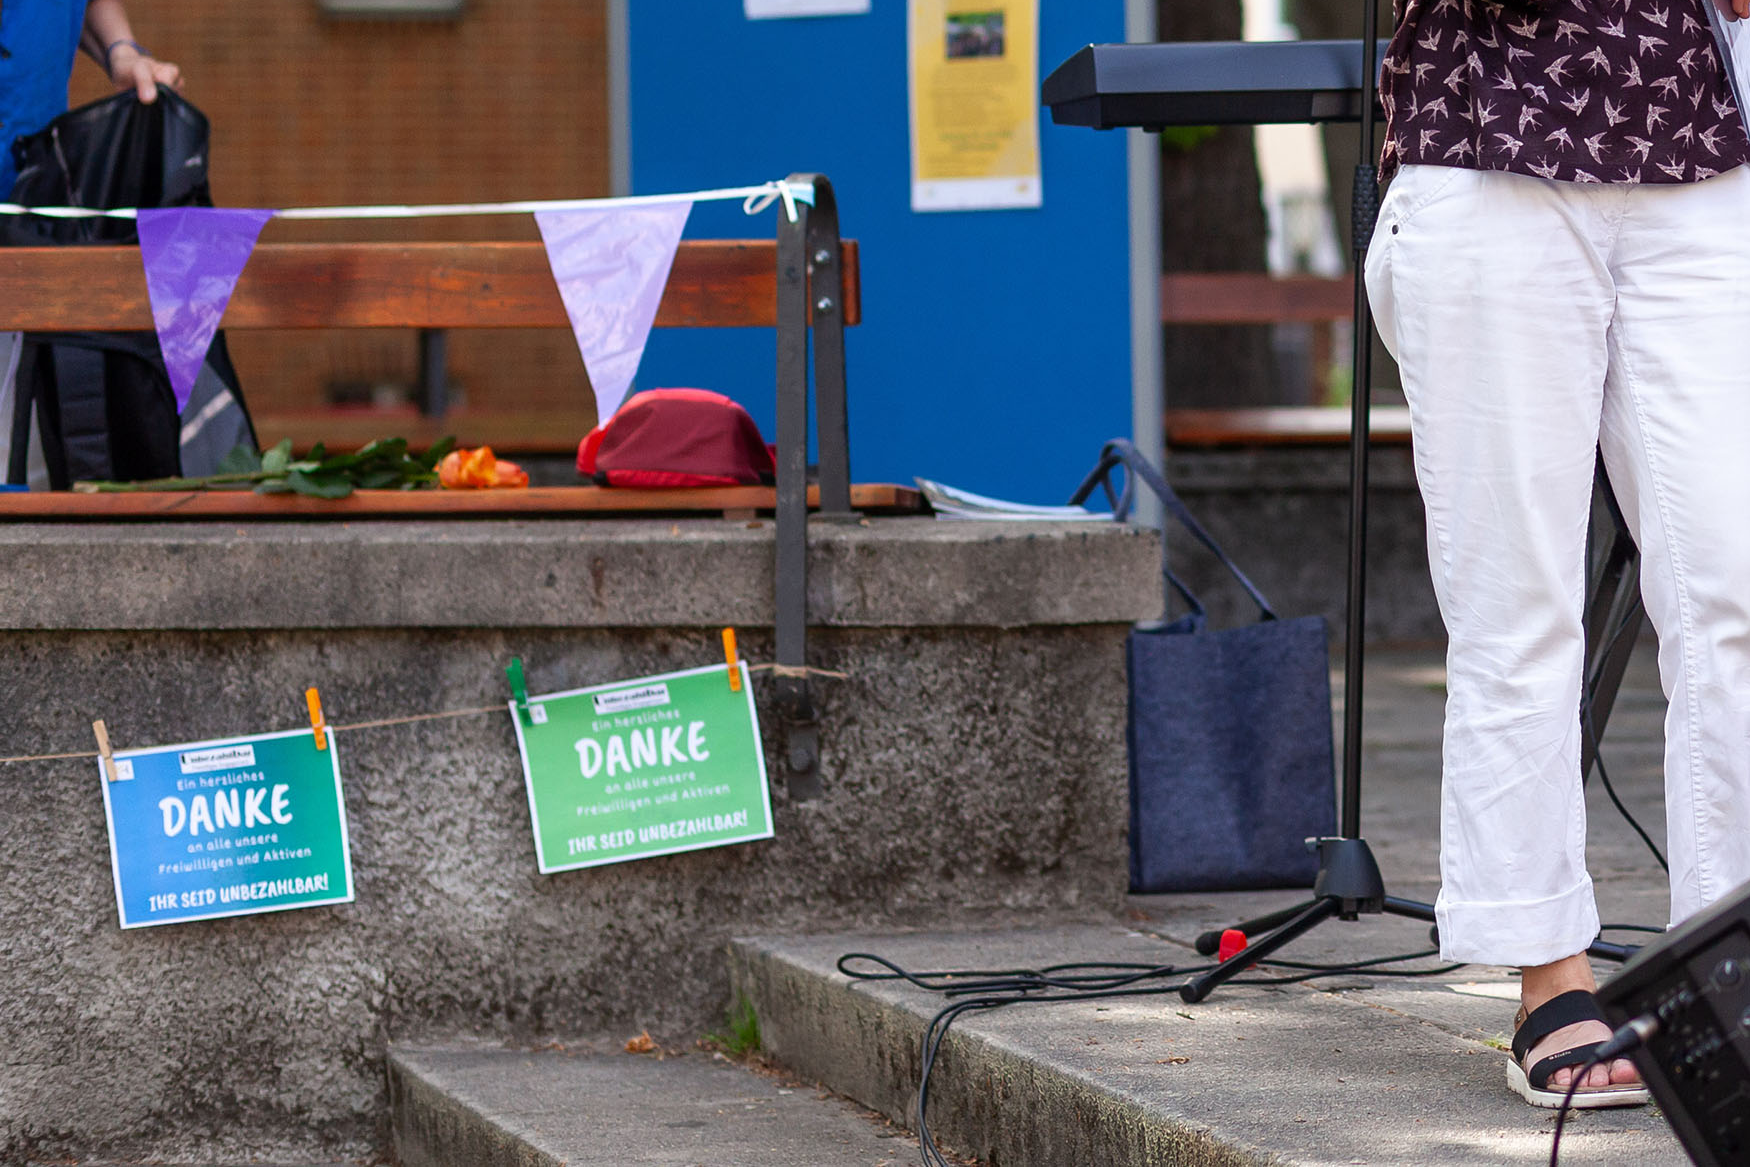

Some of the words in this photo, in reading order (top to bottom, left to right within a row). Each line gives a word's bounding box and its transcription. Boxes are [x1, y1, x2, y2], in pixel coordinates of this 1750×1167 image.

[592, 720, 612, 732] Ein
[574, 721, 710, 779] DANKE
[176, 779, 196, 791] Ein
[605, 783, 621, 794] an
[624, 777, 649, 791] alle
[652, 770, 696, 786] unsere
[158, 783, 293, 837] DANKE
[576, 796, 651, 816] Freiwilligen
[655, 790, 678, 804] und
[682, 783, 731, 799] Aktiven
[187, 843, 203, 854] an
[206, 837, 232, 852] alle
[235, 833, 279, 848] unsere
[567, 835, 597, 856] IHR
[599, 828, 635, 850] SEID
[638, 808, 748, 843] UNBEZAHLBAR!
[158, 857, 234, 875] Freiwilligen
[236, 851, 260, 866] und
[263, 847, 312, 862] Aktiven
[149, 892, 178, 912] IHR
[181, 887, 216, 908] SEID
[220, 872, 329, 903] UNBEZAHLBAR!
